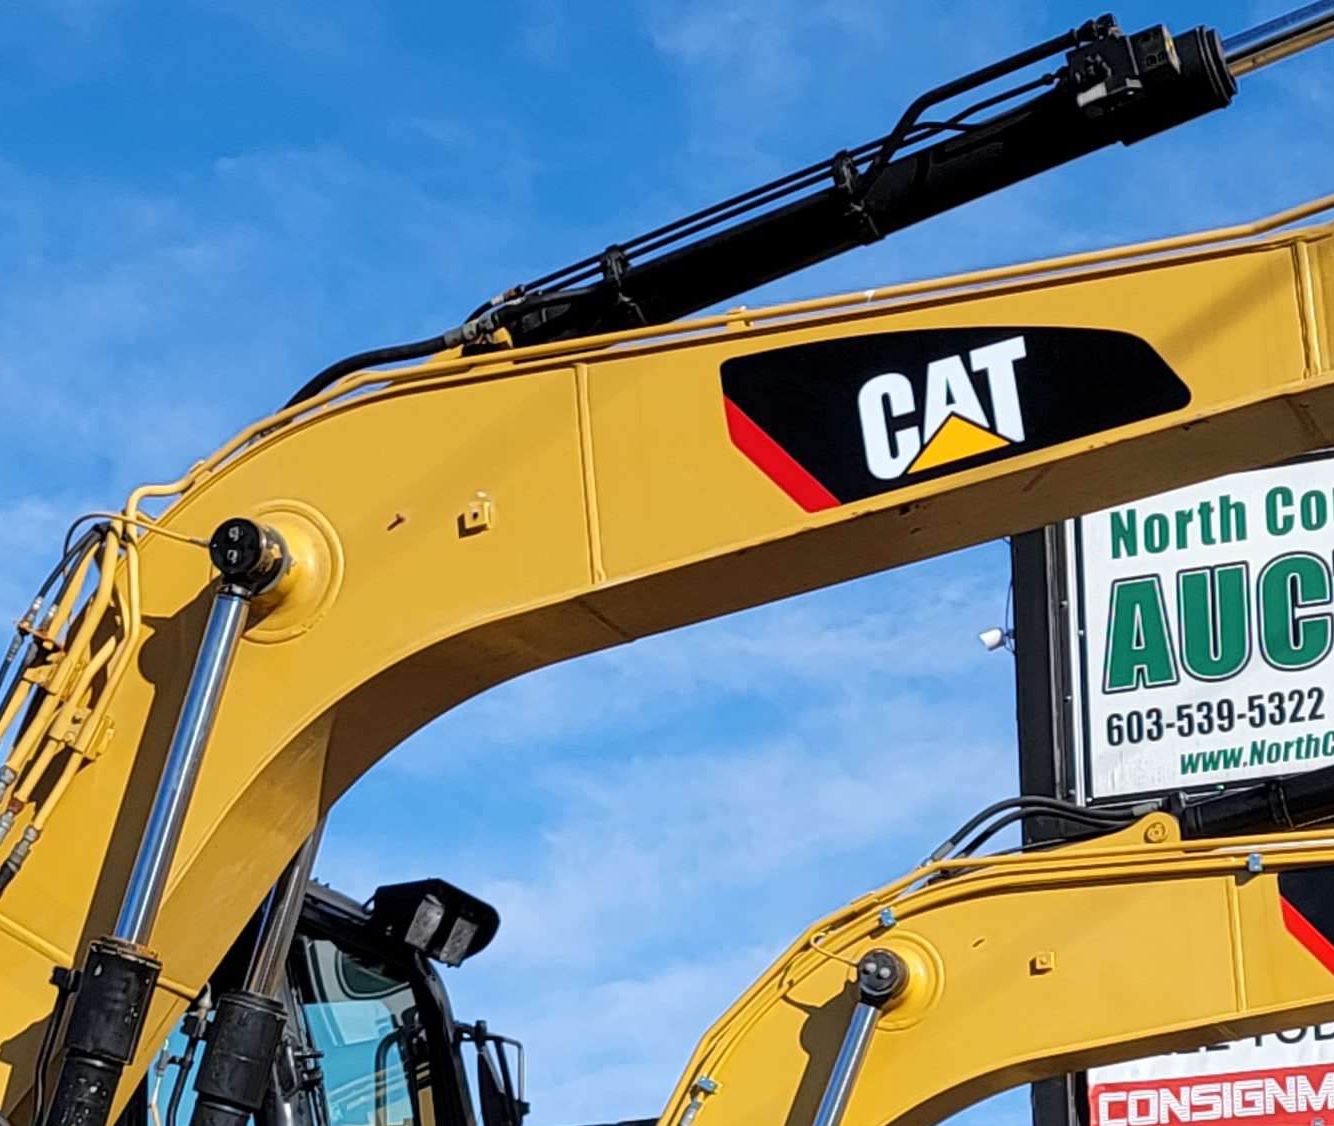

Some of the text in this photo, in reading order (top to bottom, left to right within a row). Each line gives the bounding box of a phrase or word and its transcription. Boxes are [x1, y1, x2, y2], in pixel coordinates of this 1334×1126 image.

[857, 335, 1027, 480] CAT
[1109, 494, 1248, 559] North
[1106, 687, 1325, 746] 603-539-5322
